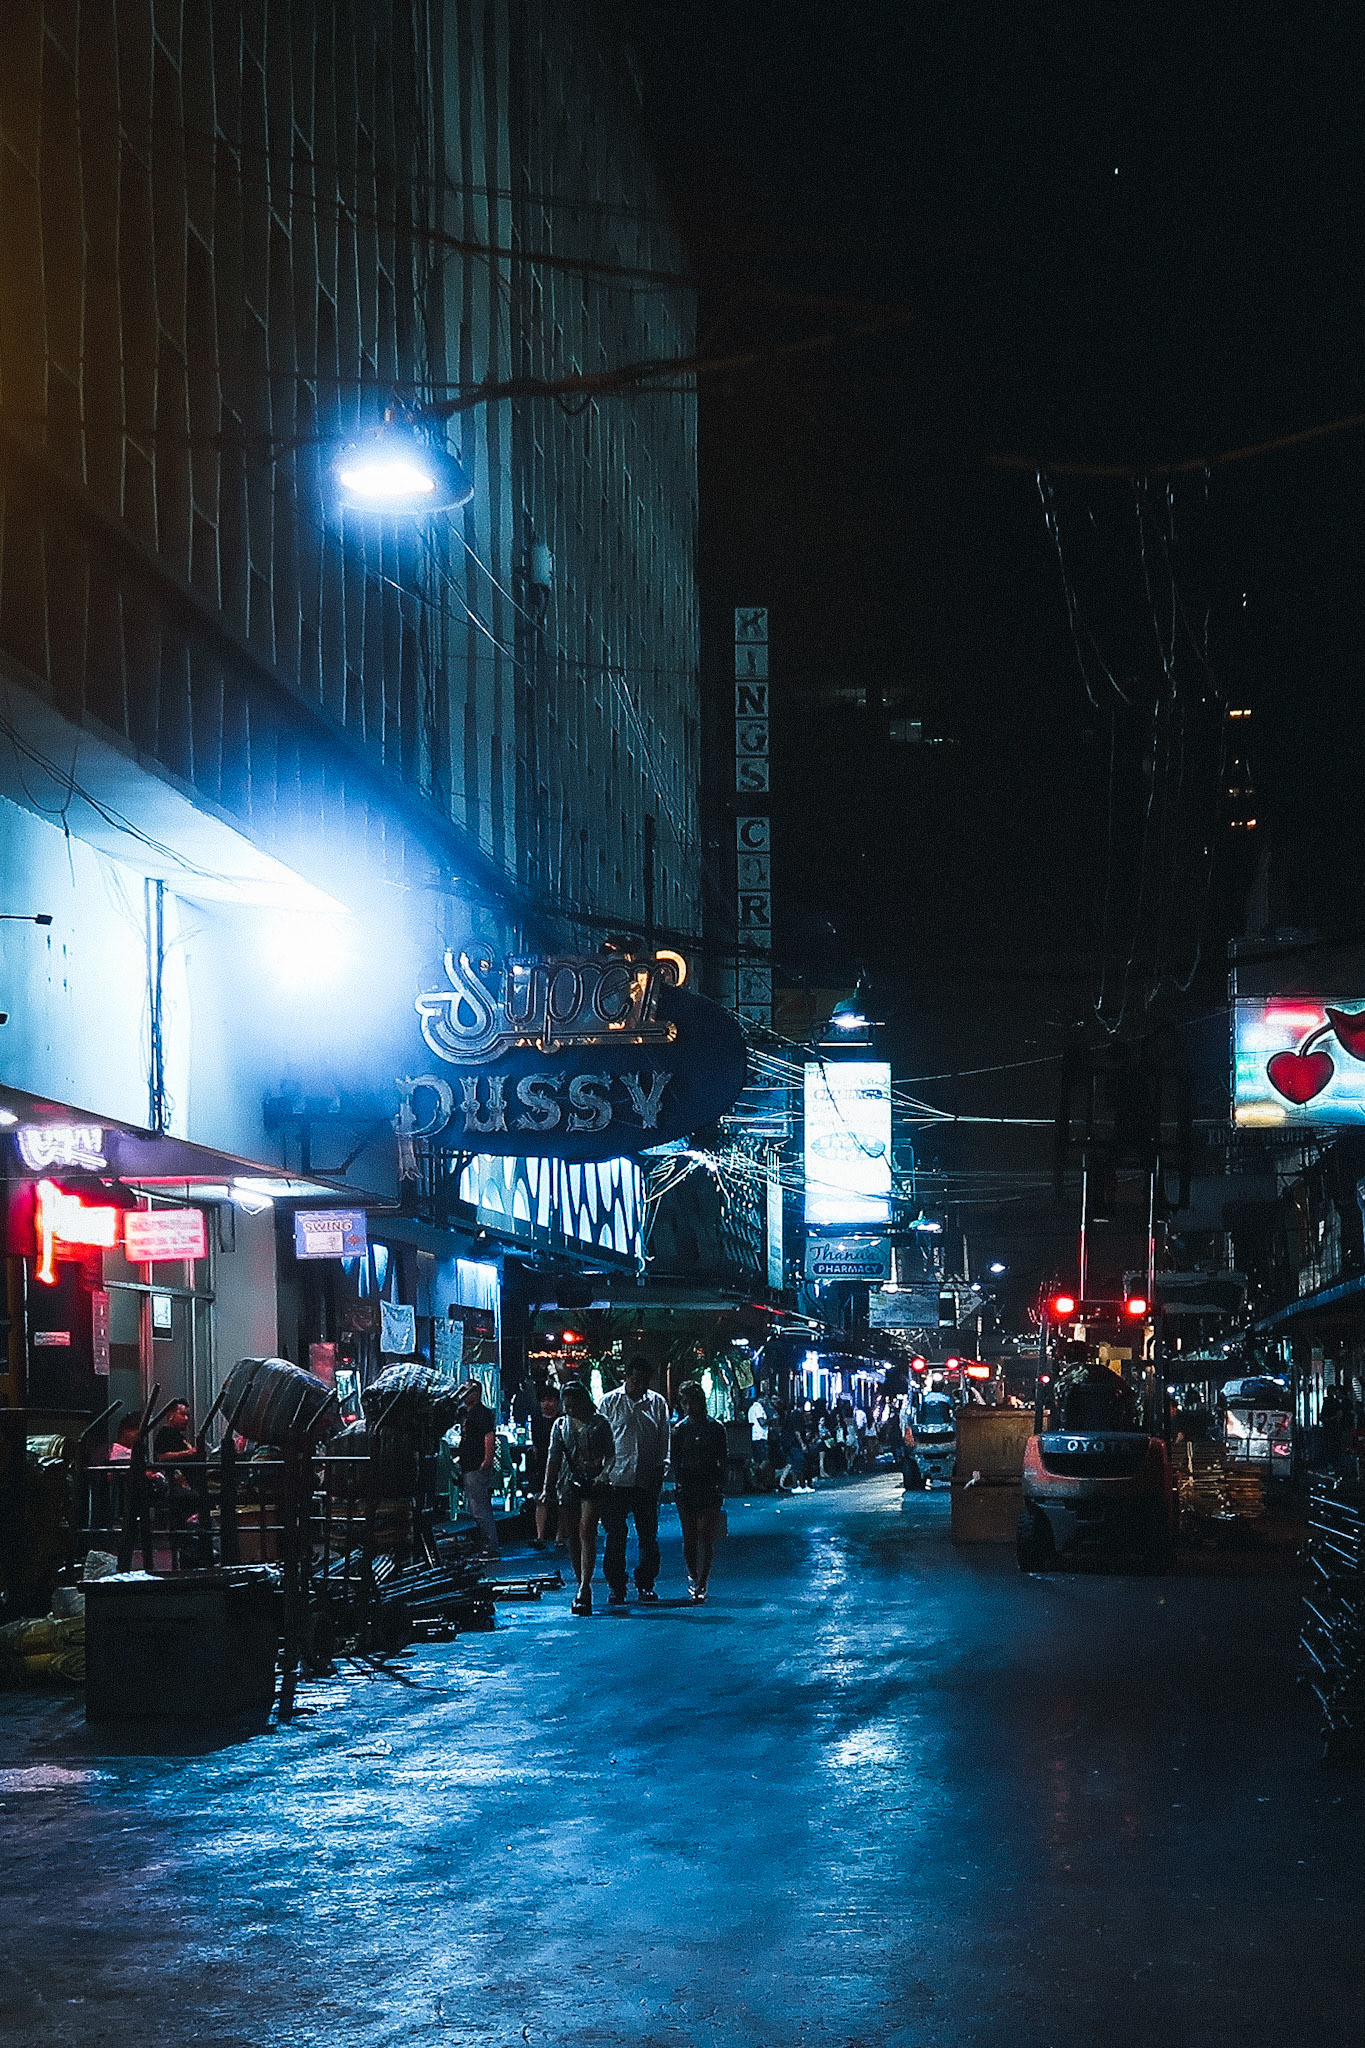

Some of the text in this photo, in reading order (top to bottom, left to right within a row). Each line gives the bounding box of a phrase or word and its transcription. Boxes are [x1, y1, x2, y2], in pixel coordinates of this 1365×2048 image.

[737, 610, 769, 790] KINGS
[414, 942, 690, 1065] Super
[392, 1071, 673, 1181] PUSSY
[304, 1220, 352, 1232] SWING
[818, 1265, 878, 1273] PHARMACY
